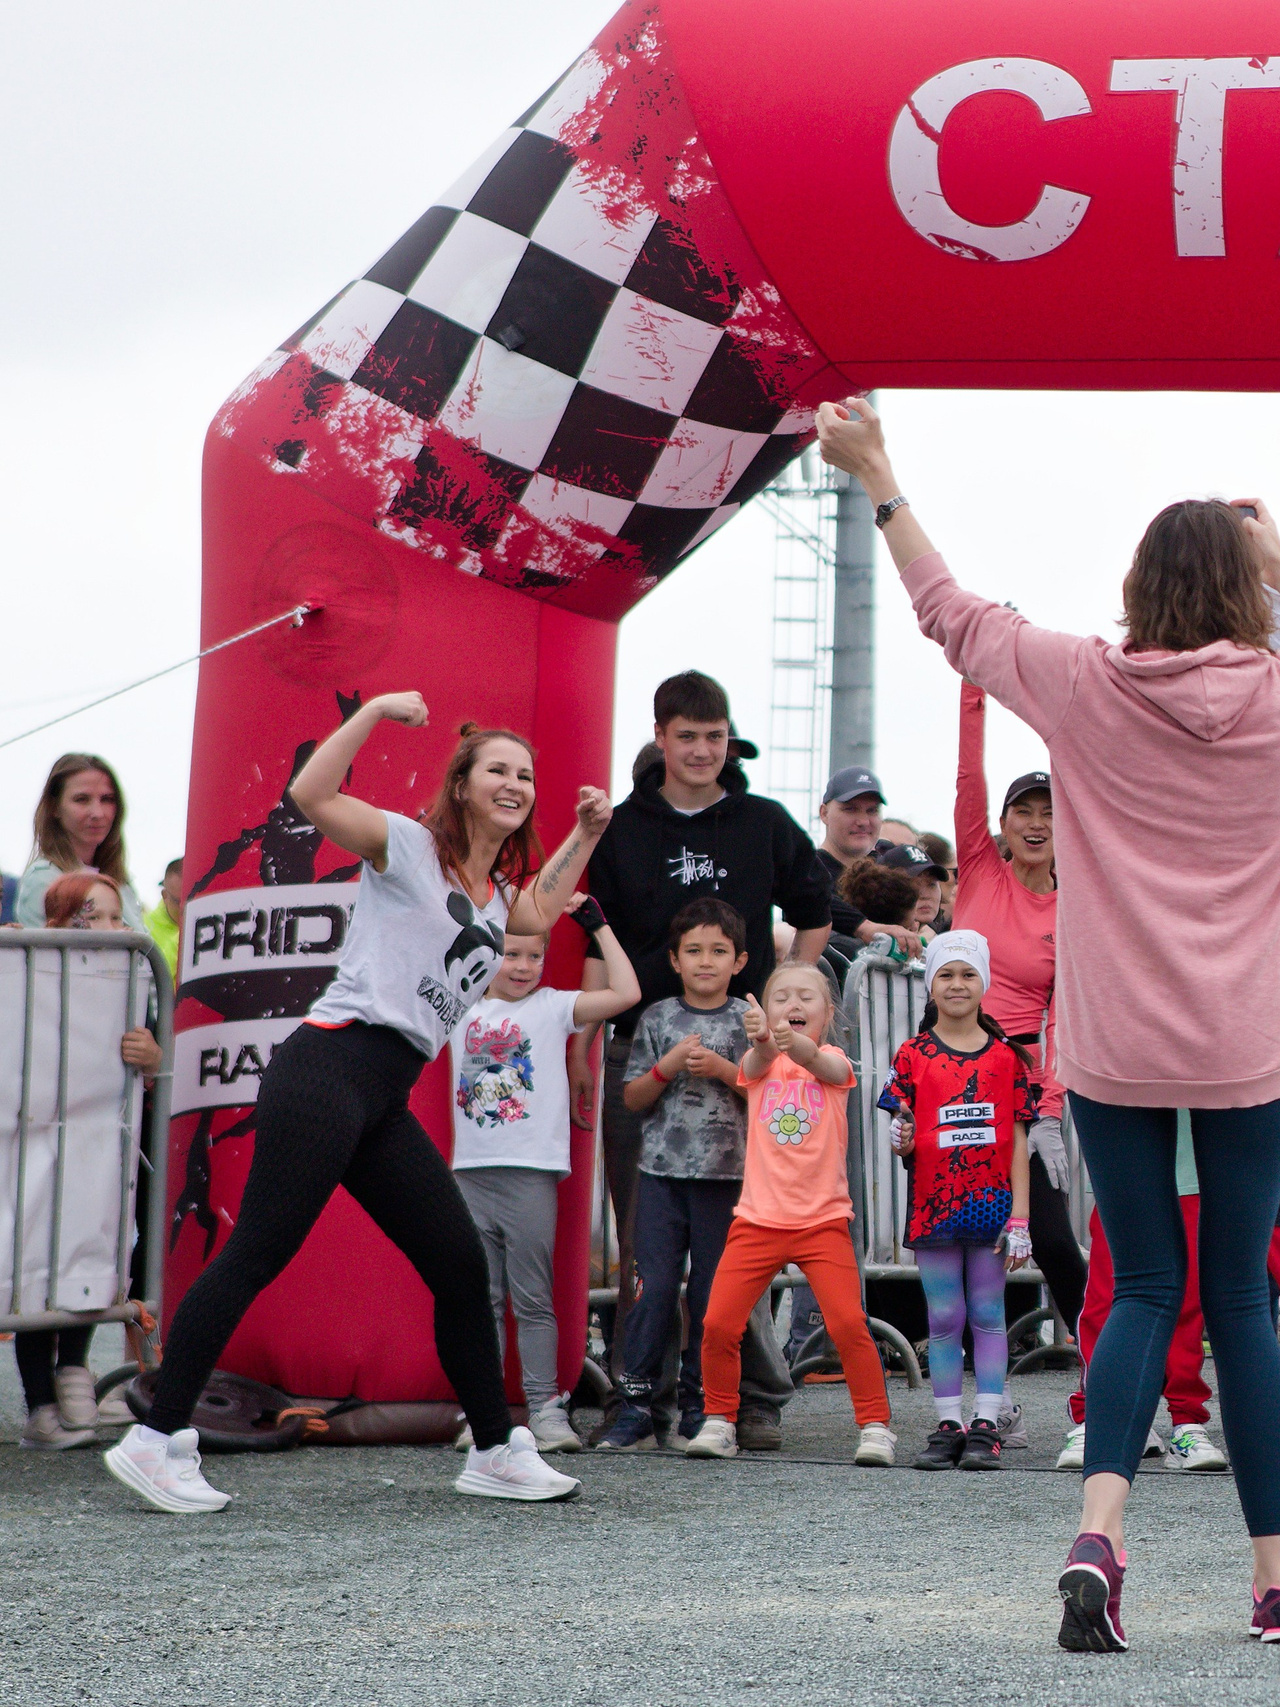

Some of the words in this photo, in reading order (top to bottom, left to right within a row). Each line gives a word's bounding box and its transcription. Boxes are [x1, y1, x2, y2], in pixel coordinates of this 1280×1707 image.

[193, 903, 355, 966] PRID
[759, 1080, 826, 1124] GAP
[945, 1107, 991, 1119] PRIDE
[952, 1132, 985, 1142] RACE
